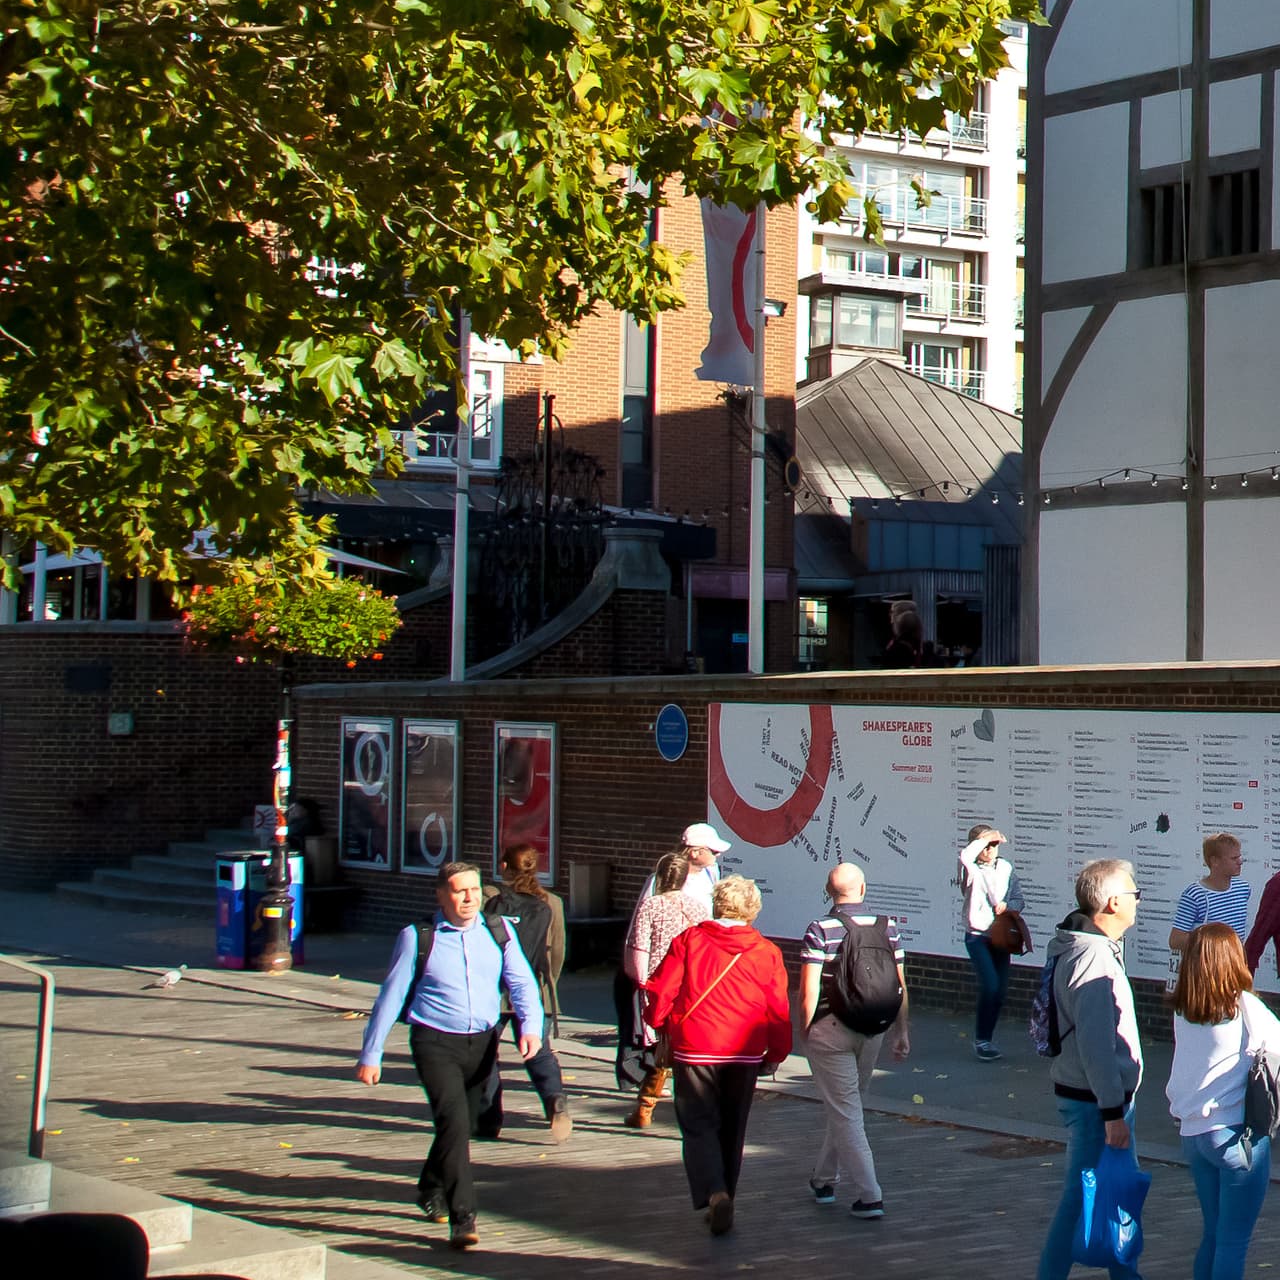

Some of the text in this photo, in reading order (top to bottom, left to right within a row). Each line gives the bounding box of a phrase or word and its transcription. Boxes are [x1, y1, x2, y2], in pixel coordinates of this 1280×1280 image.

[863, 721, 932, 732] SHAKESPEARE'S
[950, 726, 966, 739] April
[902, 735, 932, 747] GLOBE
[771, 751, 802, 779] READ NOT
[892, 763, 917, 773] Summer
[823, 796, 837, 861] CENSORSHIP
[1129, 820, 1148, 834] June
